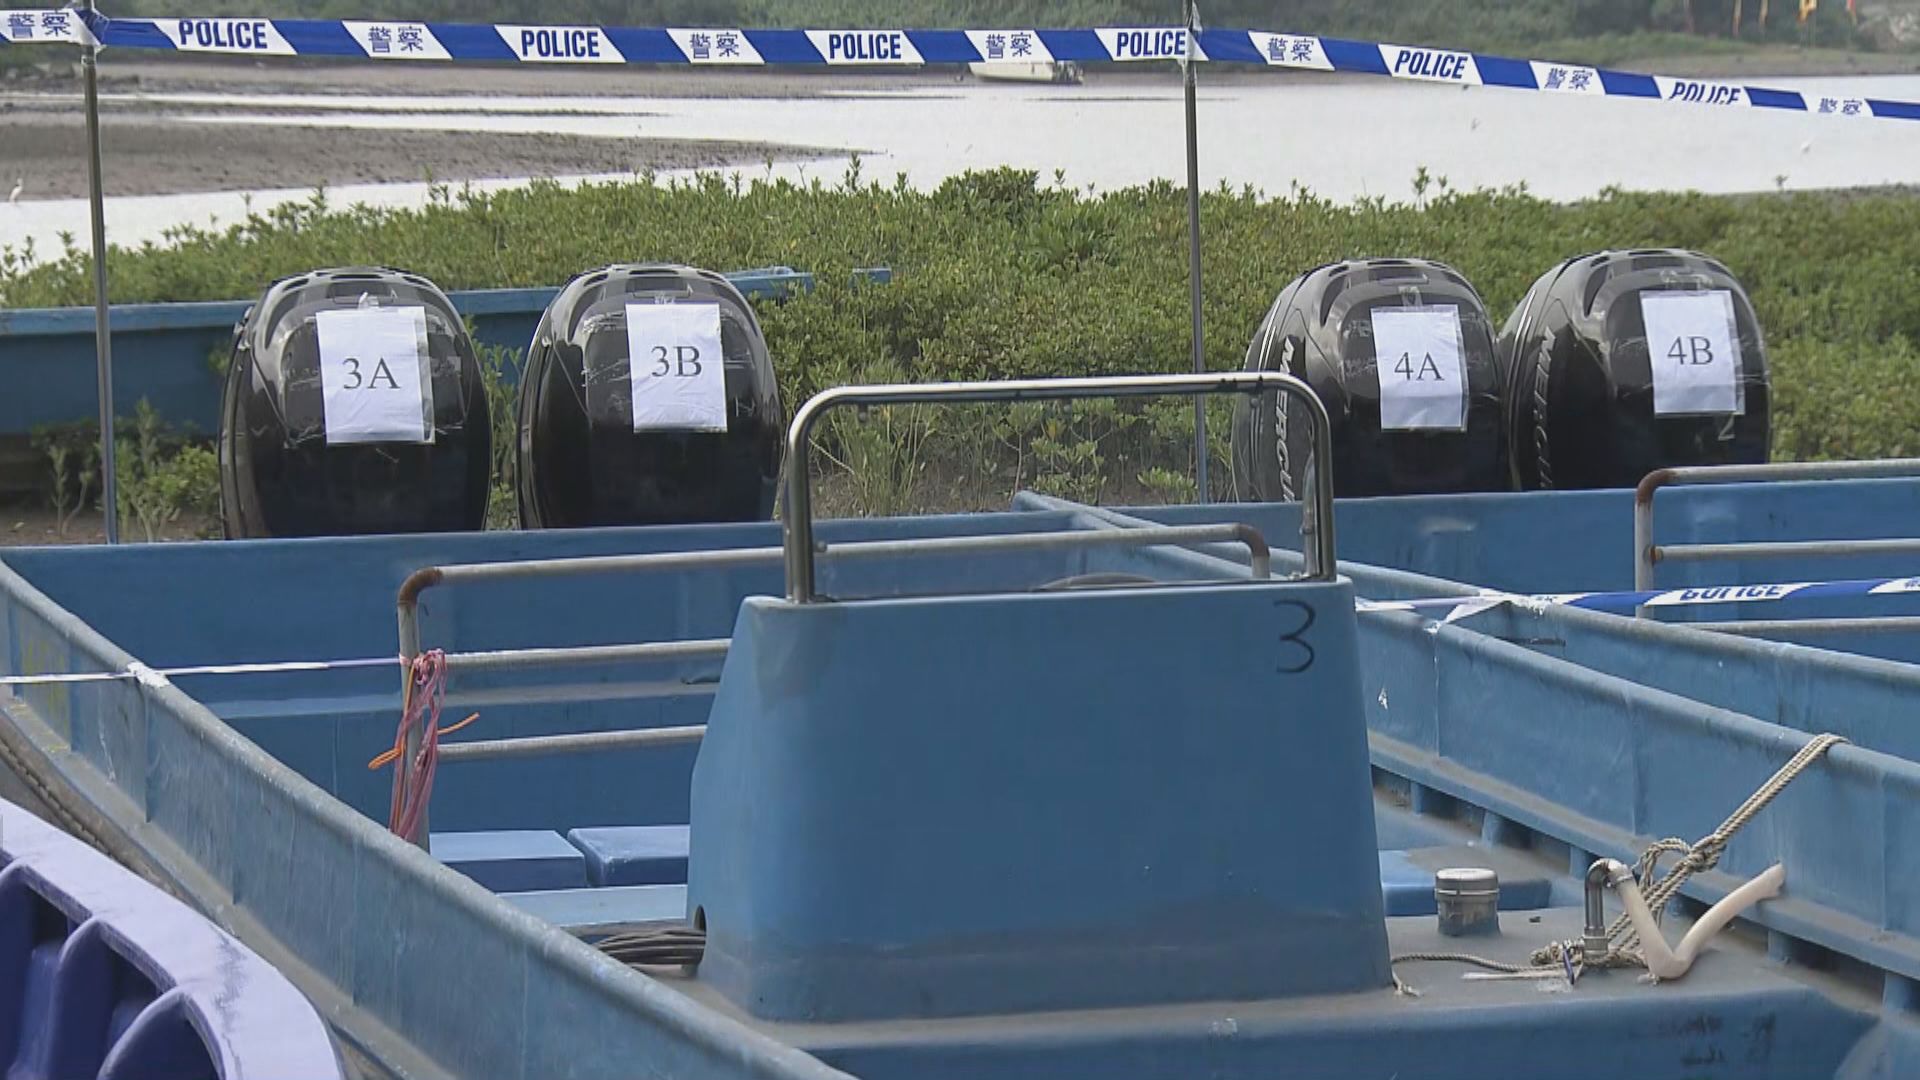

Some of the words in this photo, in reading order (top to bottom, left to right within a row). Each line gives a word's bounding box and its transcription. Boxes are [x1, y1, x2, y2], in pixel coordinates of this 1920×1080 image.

[8, 9, 71, 38] 警察
[178, 20, 268, 49] POLICE
[368, 26, 424, 52] 警察
[521, 30, 600, 57] POLICE
[690, 32, 739, 59] 警察
[829, 33, 901, 60] POLICE
[986, 32, 1032, 59] 警察
[1117, 31, 1186, 57] POLICE
[1267, 37, 1315, 62] 警察
[1395, 50, 1469, 79] POLICE
[1544, 67, 1593, 91] 警察
[651, 346, 702, 377] 3B
[1667, 336, 1714, 365] 4B
[342, 357, 401, 389] 3A
[1394, 352, 1445, 381] 4A
[1274, 599, 1316, 673] 3
